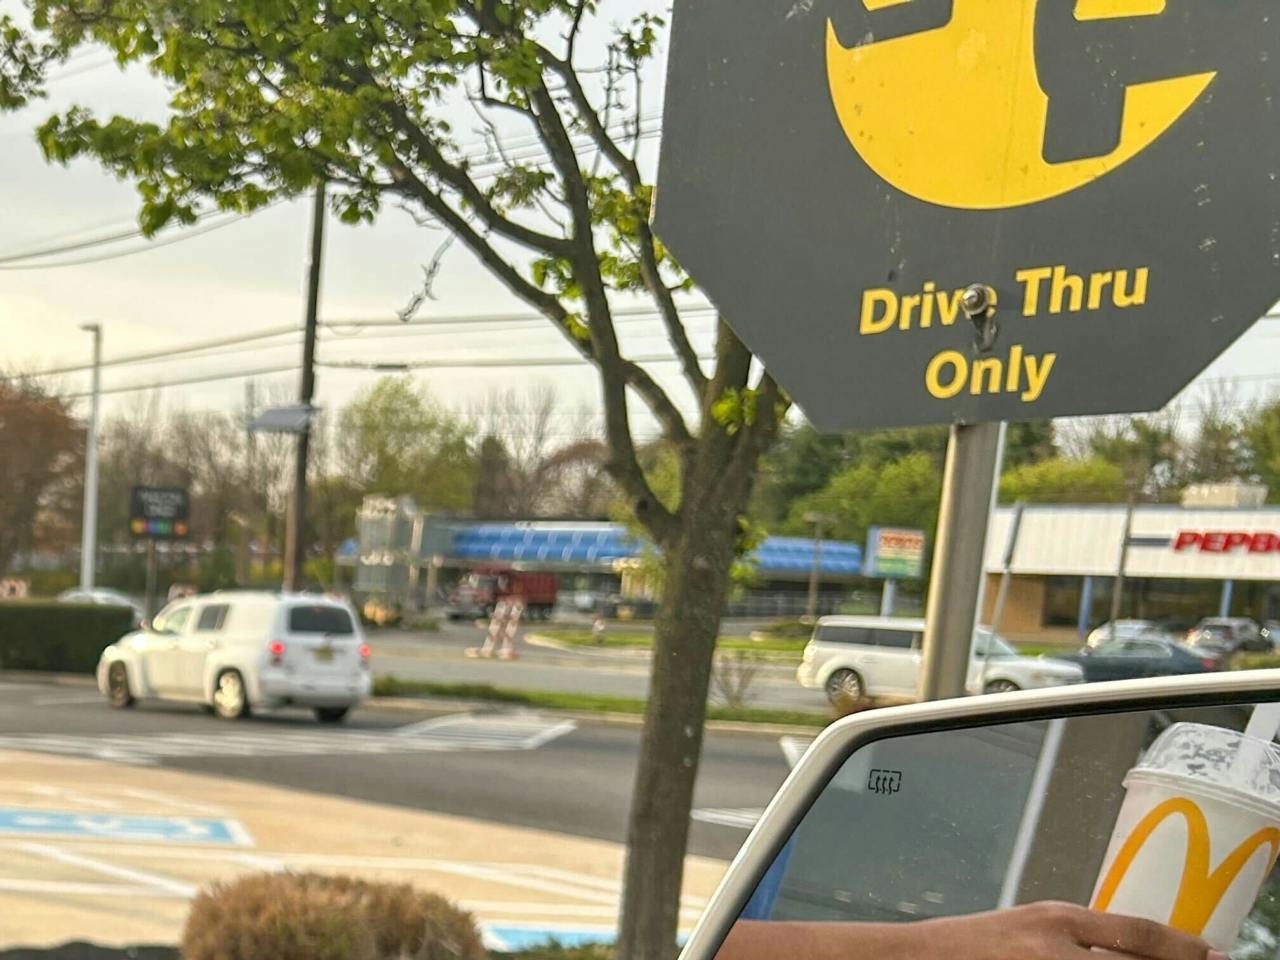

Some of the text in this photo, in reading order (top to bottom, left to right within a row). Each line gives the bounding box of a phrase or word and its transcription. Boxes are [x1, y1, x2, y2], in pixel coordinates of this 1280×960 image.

[1015, 265, 1149, 317] Thru
[925, 345, 1056, 402] Only
[1173, 531, 1280, 552] PEPB
